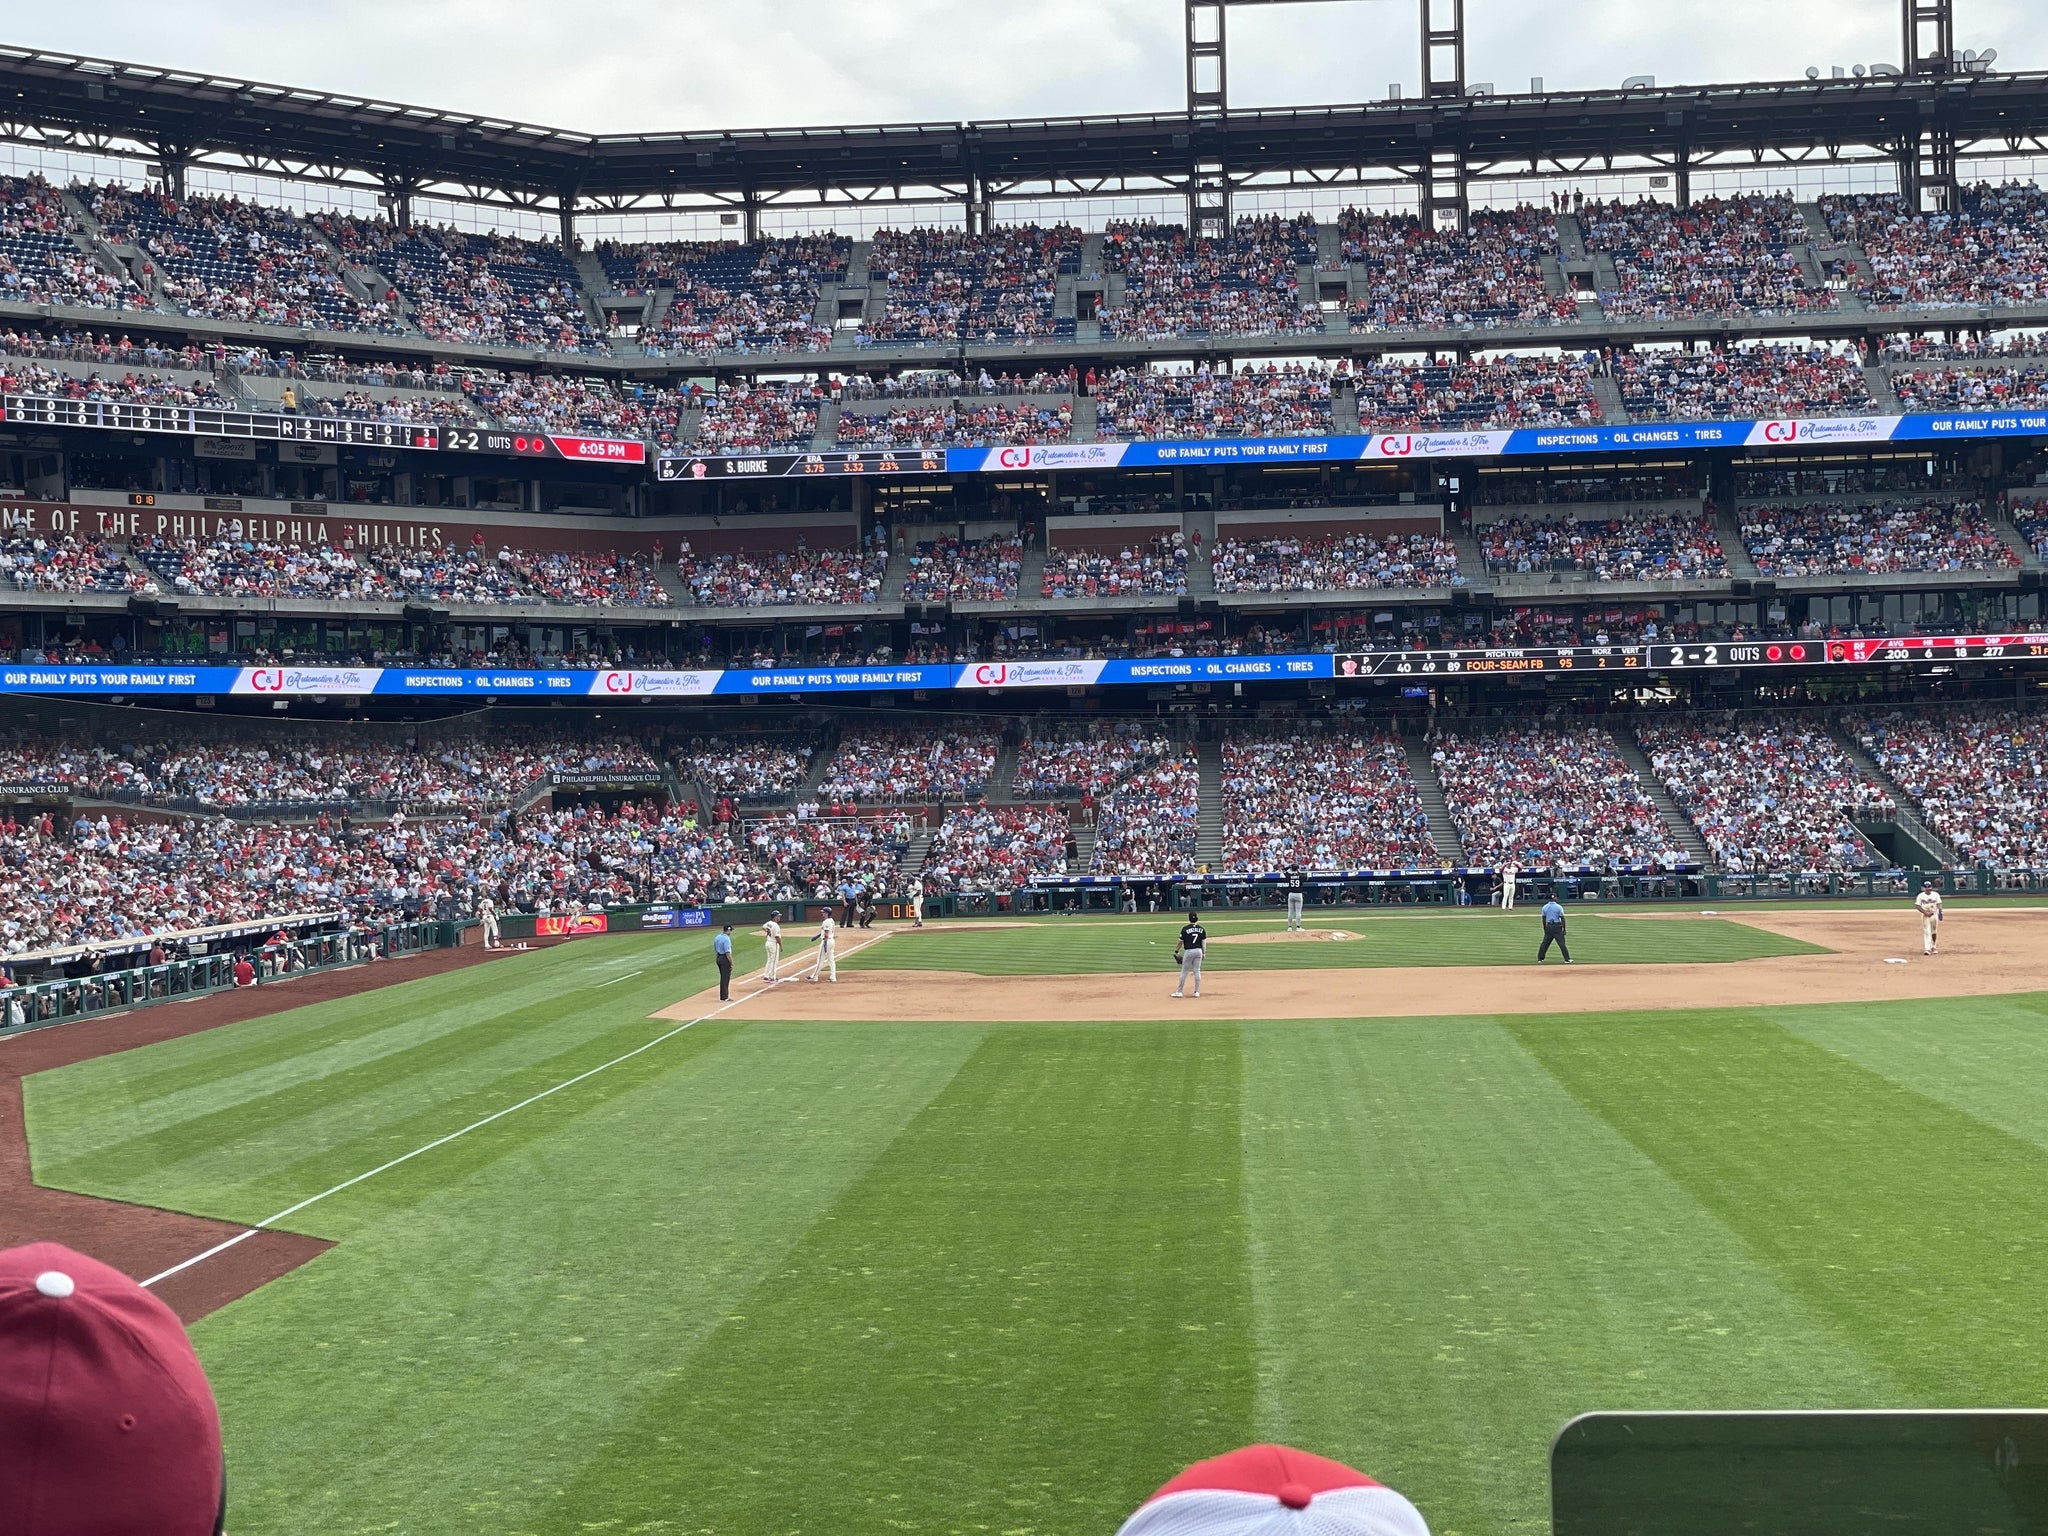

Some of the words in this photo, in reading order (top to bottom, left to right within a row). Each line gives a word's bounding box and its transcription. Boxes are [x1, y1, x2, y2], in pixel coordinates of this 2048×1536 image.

[16, 399, 24, 408] 4
[47, 401, 55, 410] 0
[79, 403, 86, 412] 2
[112, 406, 120, 414] 0
[143, 408, 150, 417] 0
[172, 410, 179, 418] 0
[17, 411, 24, 420] 0
[47, 413, 55, 422] 0
[78, 415, 86, 424] 0
[113, 418, 119, 426] 1
[143, 419, 150, 428] 0
[172, 421, 178, 430] 1
[304, 420, 312, 428] 6
[345, 422, 352, 431] 8
[1932, 421, 1952, 431] OUR
[1955, 419, 1988, 430] FAMILY
[1991, 418, 2016, 428] PUTS
[2020, 417, 2046, 428] YOUR
[283, 421, 293, 435] R
[324, 424, 334, 438] H
[364, 427, 373, 440] E
[384, 425, 392, 434] 0
[423, 428, 430, 437] 3
[1800, 422, 1848, 440] Automotive
[1858, 420, 1877, 432] Tire
[305, 431, 312, 440] 2
[346, 433, 352, 442] 3
[385, 436, 392, 445] 0
[448, 431, 479, 450] 2-2
[487, 435, 511, 449] OUTS
[1537, 434, 1599, 445] INSPECTIONS
[1614, 433, 1630, 443] OIL
[1632, 430, 1679, 442] CHANGES
[1695, 429, 1723, 440] TIRES
[424, 438, 430, 447] 2
[1415, 437, 1461, 452] Automotive
[1470, 435, 1489, 447] Tire
[579, 442, 605, 455] 6:05
[607, 444, 625, 457] PM
[921, 451, 937, 459] BB%
[1034, 449, 1078, 464] Automotive
[1088, 447, 1106, 459] Tire
[1158, 449, 1177, 459] OUR
[1180, 447, 1211, 458] FAMILY
[1215, 447, 1238, 457] PUTS
[1241, 446, 1265, 456] YOUR
[1268, 445, 1300, 455] FAMILY
[1303, 443, 1328, 454] FIRST
[726, 461, 736, 472] S.
[737, 460, 768, 472] BURKE
[805, 464, 825, 473] 3.75
[843, 463, 864, 472] 3.32
[879, 462, 899, 471] 23%
[922, 460, 937, 470] 8%
[663, 469, 674, 477] 59
[52, 509, 79, 531] OF
[97, 512, 140, 535] THE
[157, 515, 328, 542] PHILADELPHIA
[344, 523, 442, 548] HILLIES
[1888, 639, 1903, 647] AVG
[1730, 647, 1759, 661] OUTS
[1884, 650, 1909, 659] .200
[1925, 649, 1932, 658] 6
[1955, 648, 1967, 657] 18
[1982, 647, 2004, 656] .277
[2030, 646, 2041, 655] 31
[1131, 665, 1192, 675] INSPECTIONS
[1207, 664, 1222, 673] OIL
[1225, 663, 1271, 673] CHANGES
[1286, 662, 1313, 672] TIRES
[1361, 665, 1372, 674] 59
[1397, 663, 1411, 672] 40
[1422, 663, 1435, 672] 49
[1447, 662, 1461, 672] 89
[1466, 660, 1529, 671] FOUR-SEAM
[1531, 660, 1543, 669] FB
[1559, 659, 1572, 668] 95
[1599, 658, 1605, 667] 2
[1624, 657, 1637, 666] 22
[5, 674, 27, 685] OUR
[30, 674, 67, 685] FAMILY
[70, 674, 97, 685] PUTS
[101, 674, 127, 685] YOUR
[130, 674, 167, 685] FAMILY
[169, 674, 196, 685] FIRST
[752, 675, 771, 686] OUR
[773, 675, 805, 686] FAMILY
[808, 674, 832, 685] PUTS
[835, 674, 860, 684] YOUR
[862, 673, 894, 684] FAMILY
[897, 672, 922, 682] FIRST
[1010, 666, 1055, 681] Automotive
[1064, 665, 1084, 677] Tire
[286, 672, 332, 689] Automotive
[342, 672, 360, 684] Tire
[406, 676, 463, 687] INSPECTIONS
[477, 677, 491, 687] OIL
[493, 677, 535, 688] CHANGES
[548, 678, 571, 688] TIRES
[635, 674, 674, 690] Automotive
[683, 675, 700, 686] Tire
[562, 775, 607, 783] PHILADELPHIA
[608, 774, 644, 782] INSURANCE
[47, 785, 69, 793] CLUB
[892, 905, 900, 918] 0
[1192, 933, 1198, 943] 7
